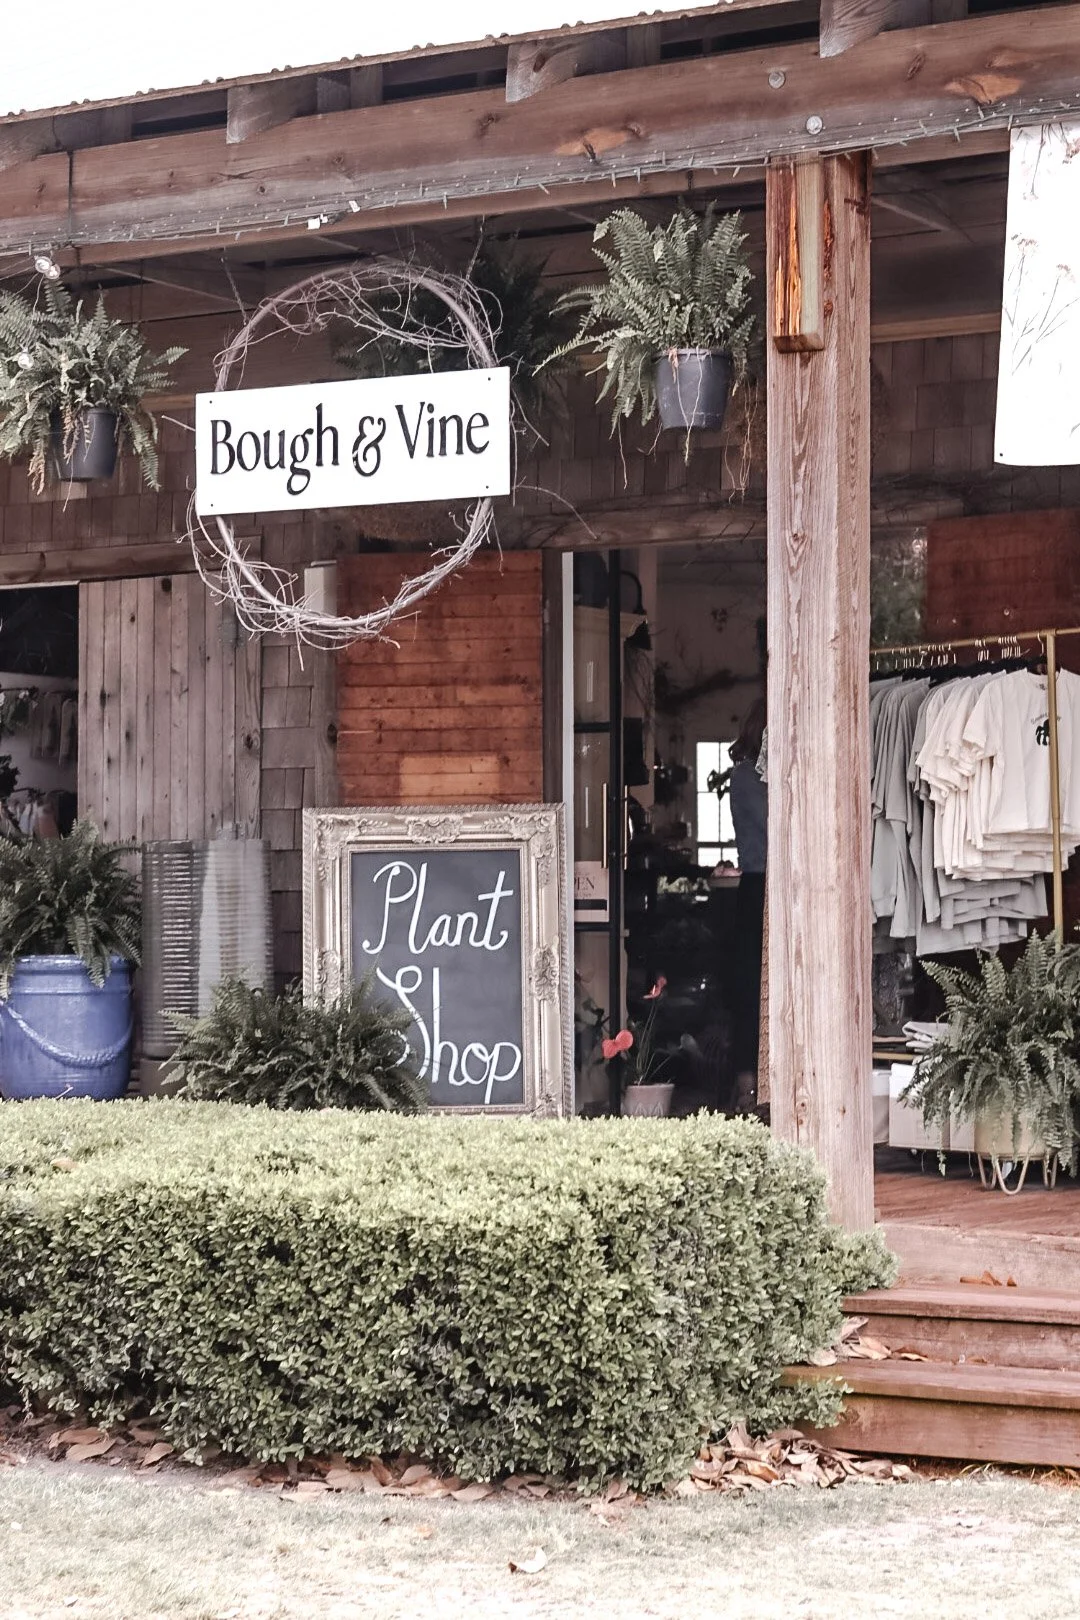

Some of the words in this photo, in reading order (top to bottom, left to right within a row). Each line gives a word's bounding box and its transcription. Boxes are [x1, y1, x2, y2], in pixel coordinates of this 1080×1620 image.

[210, 403, 339, 495] Bough
[352, 415, 386, 477] &
[395, 401, 490, 459] Vine
[362, 861, 514, 954] Plant
[374, 965, 522, 1105] Shop
